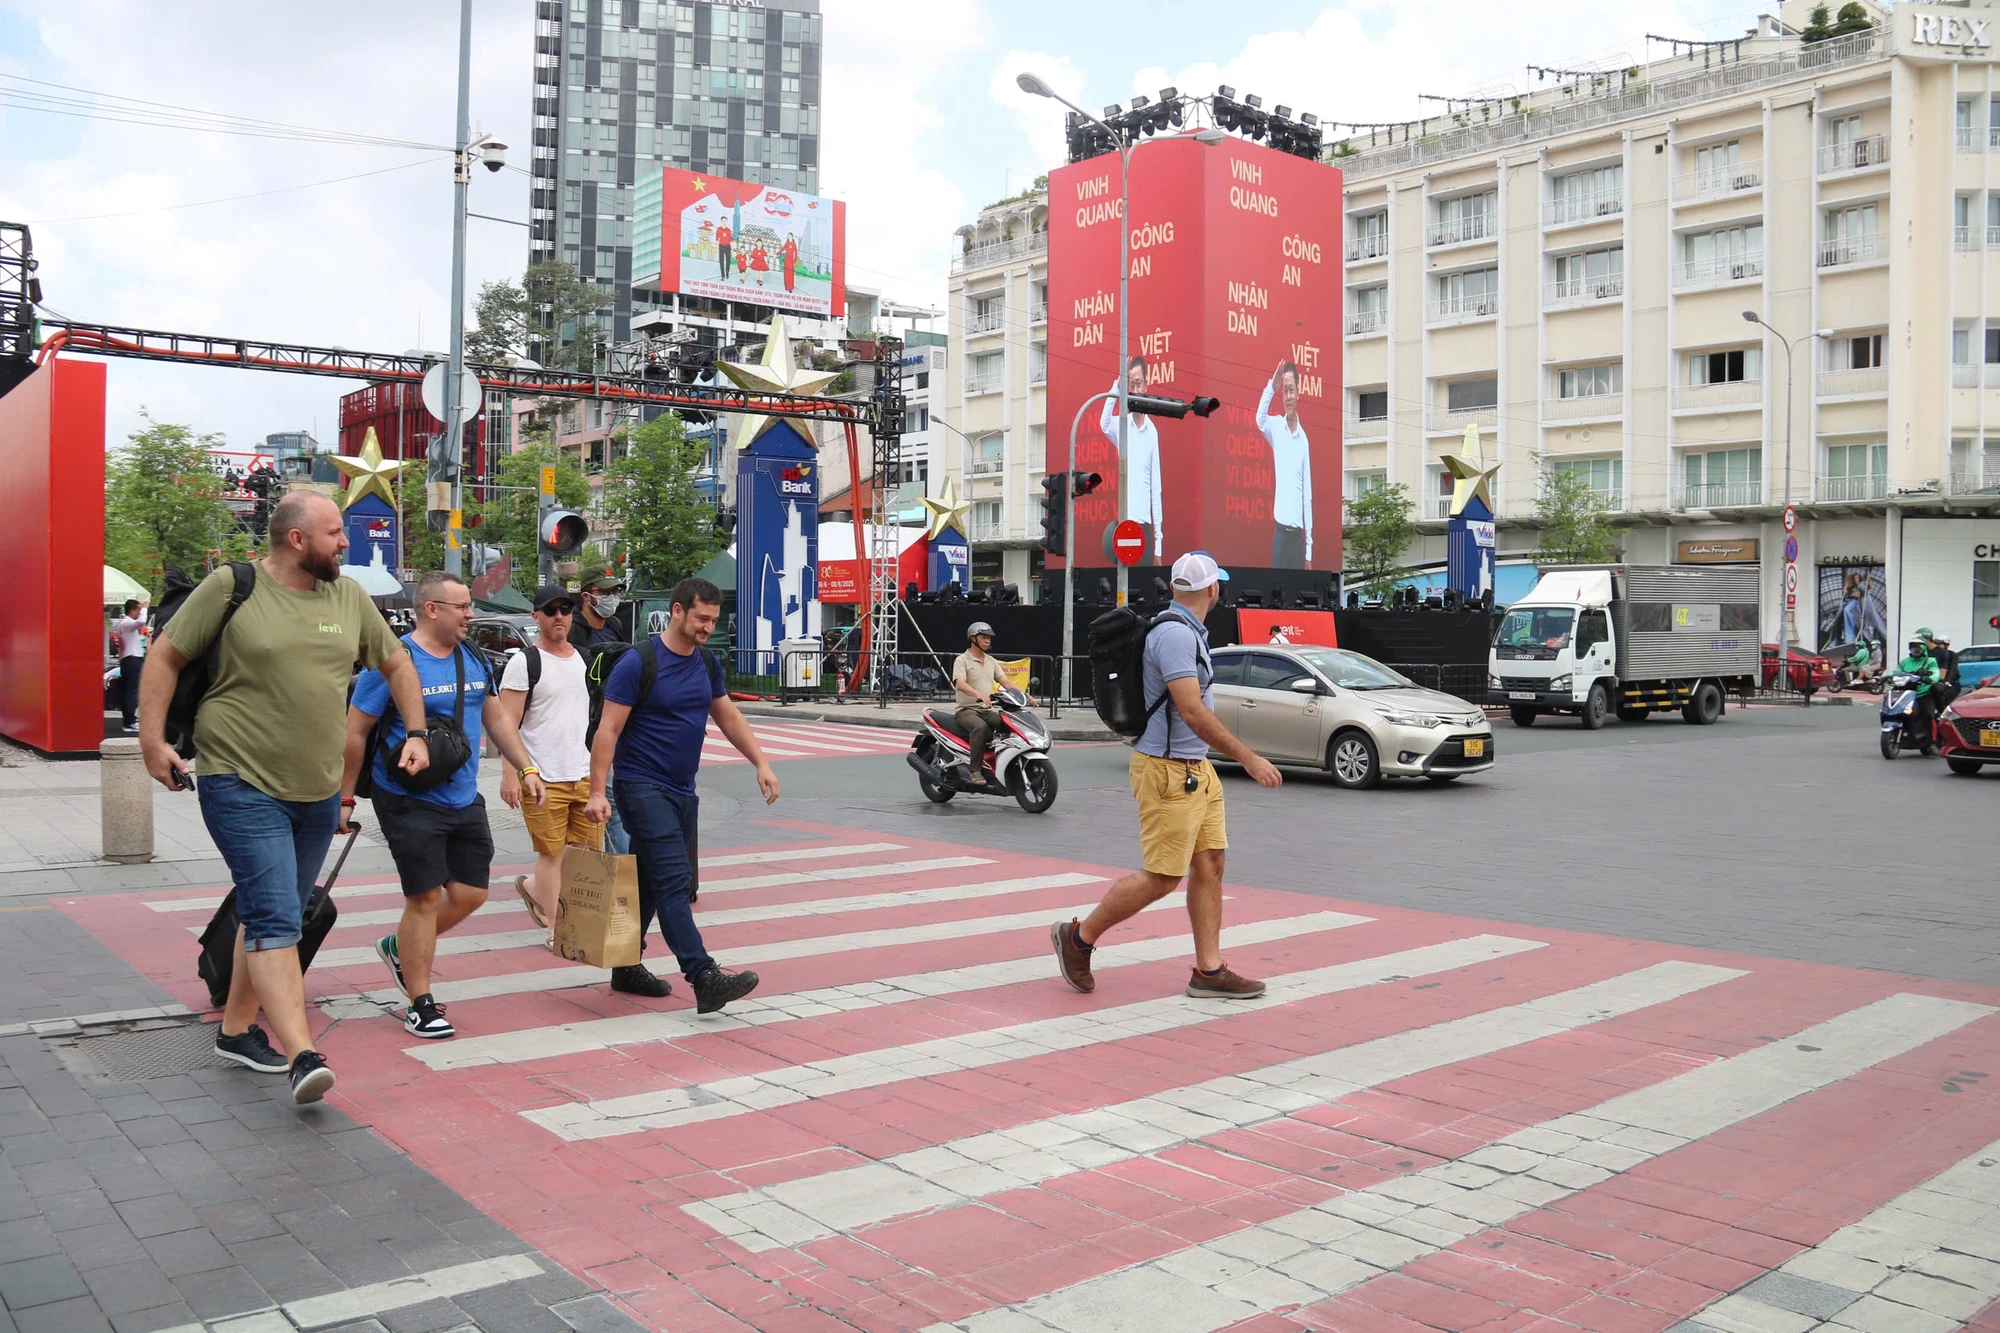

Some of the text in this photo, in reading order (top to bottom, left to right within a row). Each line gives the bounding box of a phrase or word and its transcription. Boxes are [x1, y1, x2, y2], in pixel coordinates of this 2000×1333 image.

[1912, 12, 1992, 47] REX
[1230, 157, 1262, 186] VINH
[1076, 174, 1109, 201] VINH
[1229, 185, 1278, 217] QUANG
[1076, 197, 1123, 229] QUANG
[1130, 221, 1174, 250] CÔNG
[1282, 233, 1321, 264] CÔNG
[1130, 254, 1151, 279] AN
[1282, 264, 1301, 287] AN
[1074, 289, 1115, 320] NHÂN
[1228, 280, 1268, 310] NHÂN
[1073, 320, 1103, 348] DÂN
[1228, 307, 1258, 337] DÂN
[1139, 327, 1173, 360] VIỆT
[1291, 340, 1320, 372] VIỆT
[1225, 431, 1265, 459] QUÊN
[781, 468, 801, 481] HD
[782, 480, 812, 494] Bank
[1097, 464, 1119, 491] ÂN
[1225, 495, 1266, 525] PHỤC
[369, 529, 391, 539] Bank
[1823, 555, 1877, 565] CHANEL
[422, 684, 454, 696] OLEJORZ
